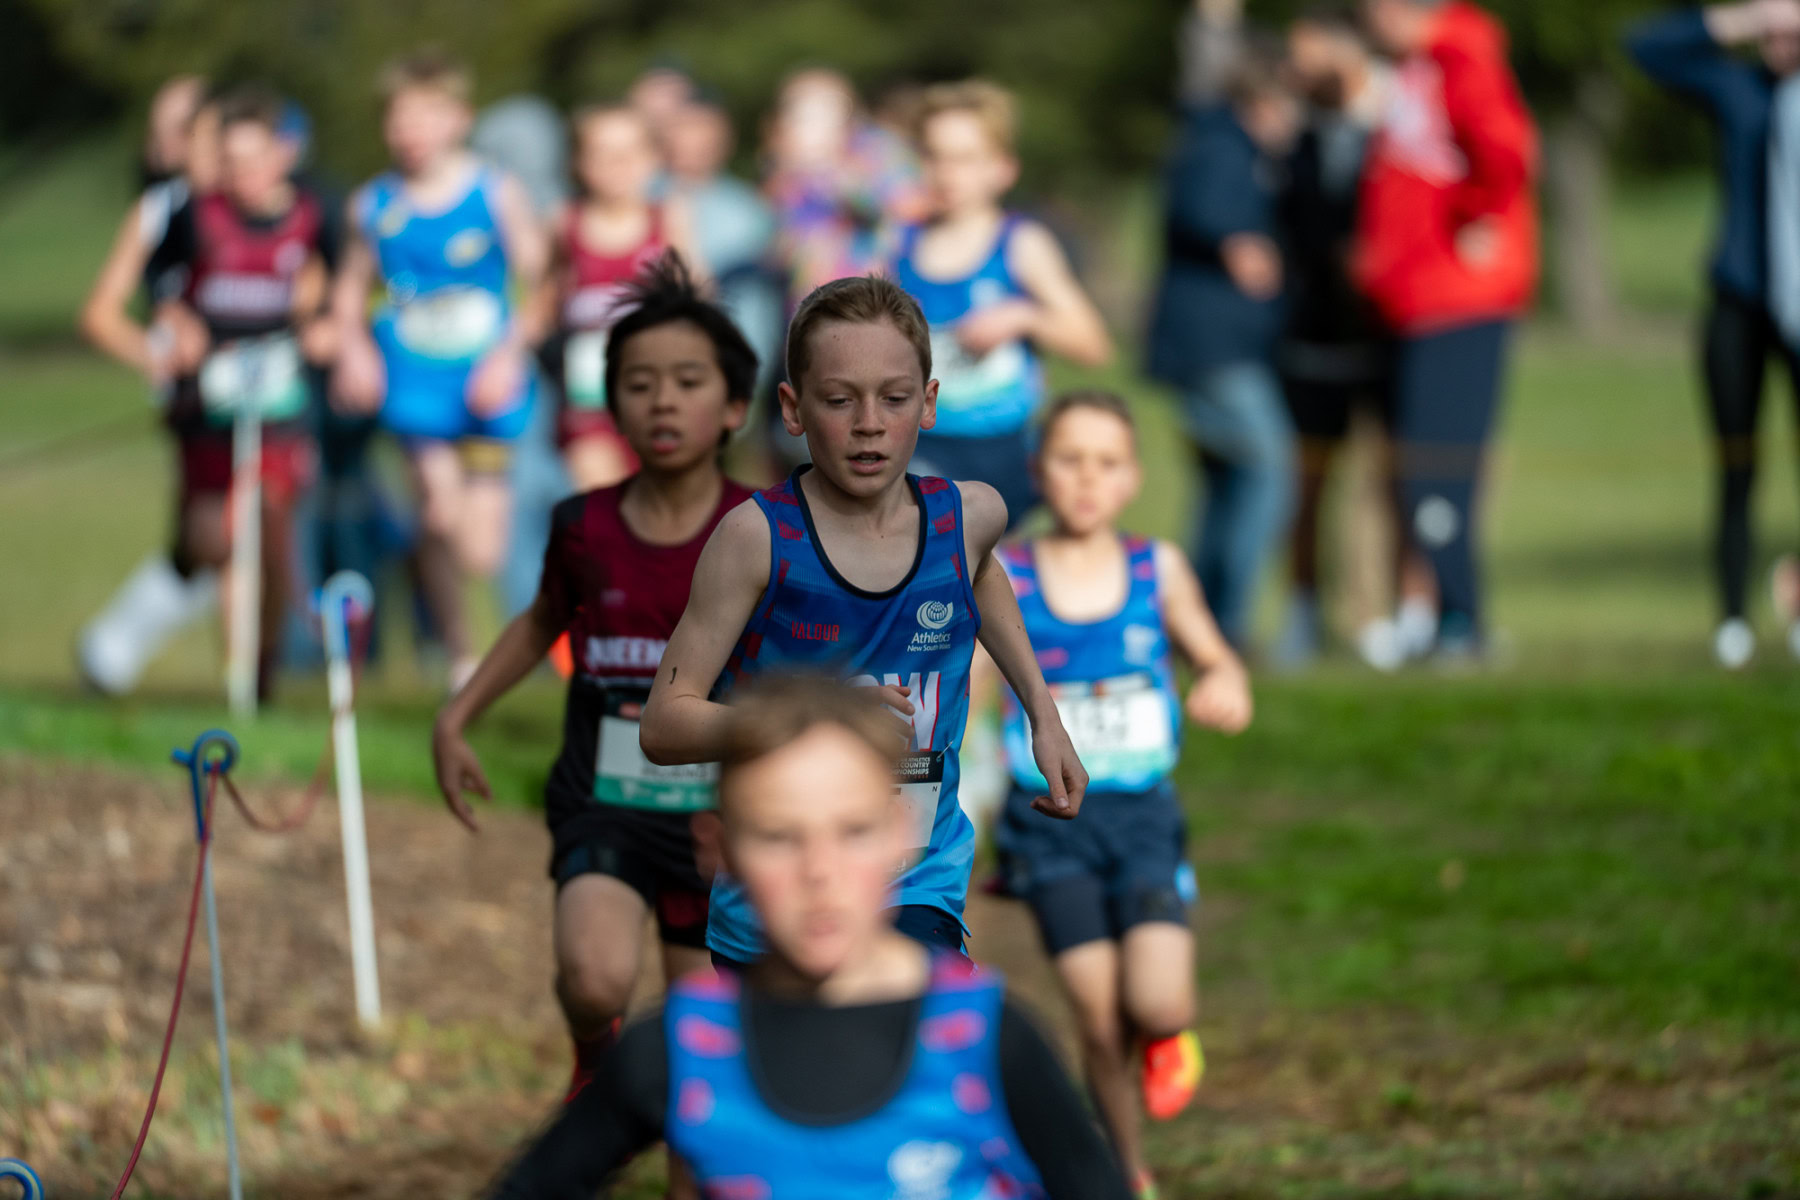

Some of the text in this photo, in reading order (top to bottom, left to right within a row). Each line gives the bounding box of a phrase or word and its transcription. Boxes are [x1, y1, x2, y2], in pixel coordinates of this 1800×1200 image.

[792, 621, 840, 642] VALOUR
[911, 631, 951, 644] Athletics
[907, 645, 923, 653] New
[923, 644, 938, 652] South
